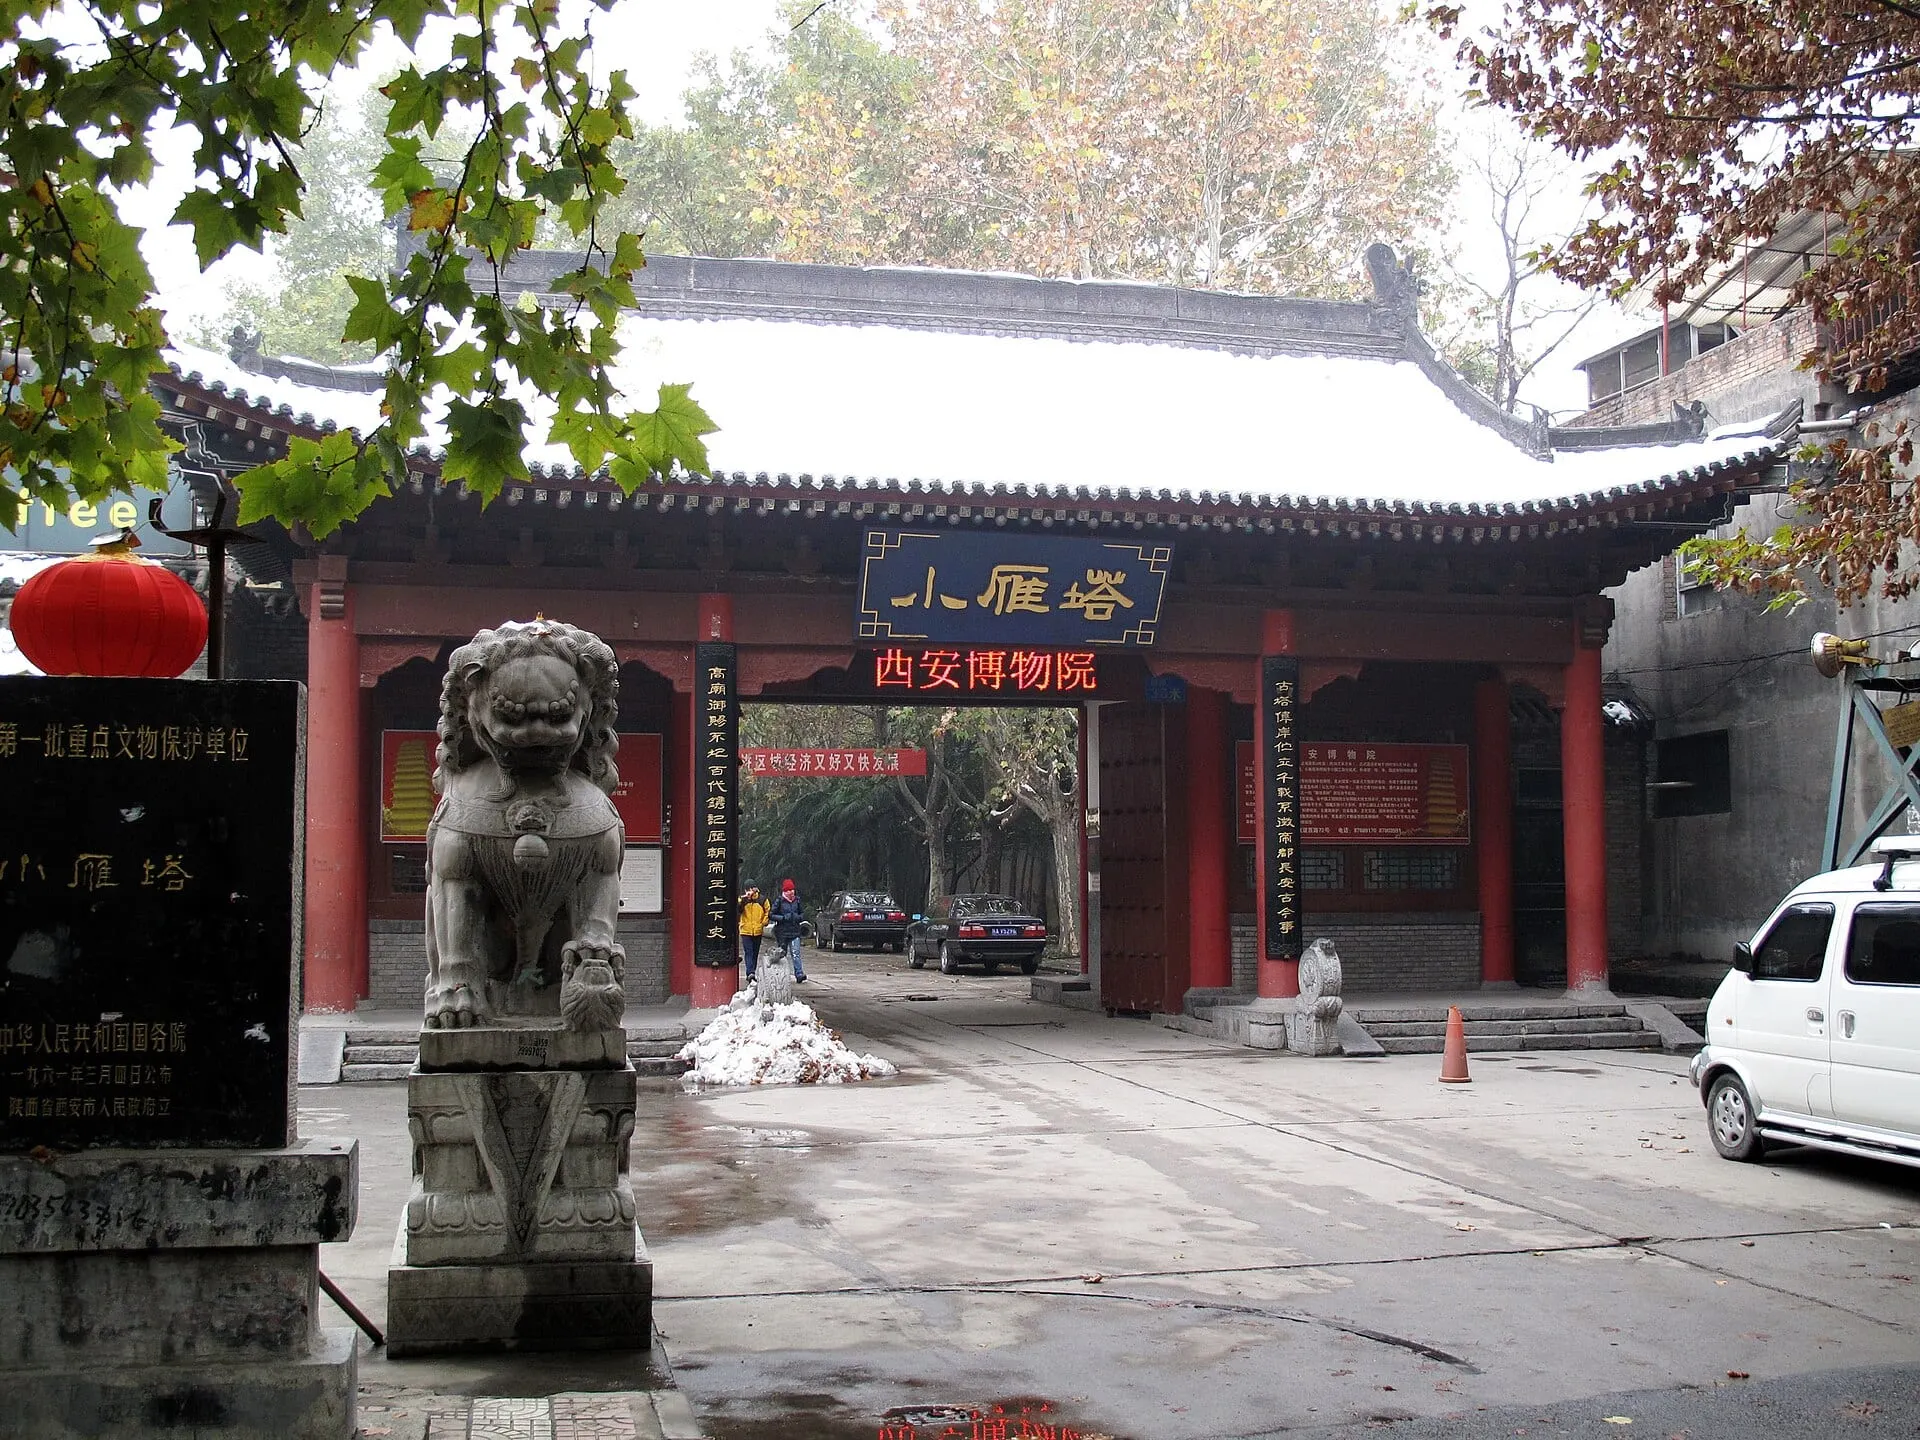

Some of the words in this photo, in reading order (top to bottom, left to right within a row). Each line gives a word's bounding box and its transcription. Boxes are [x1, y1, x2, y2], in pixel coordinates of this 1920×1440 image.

[890, 565, 1134, 621] 小雁塔
[874, 648, 1097, 691] 西安博物院
[0, 723, 250, 763] 第一批重点文物保护单位
[0, 853, 194, 891] 小雁塔
[0, 1022, 188, 1055] 中华人民共和国国务院
